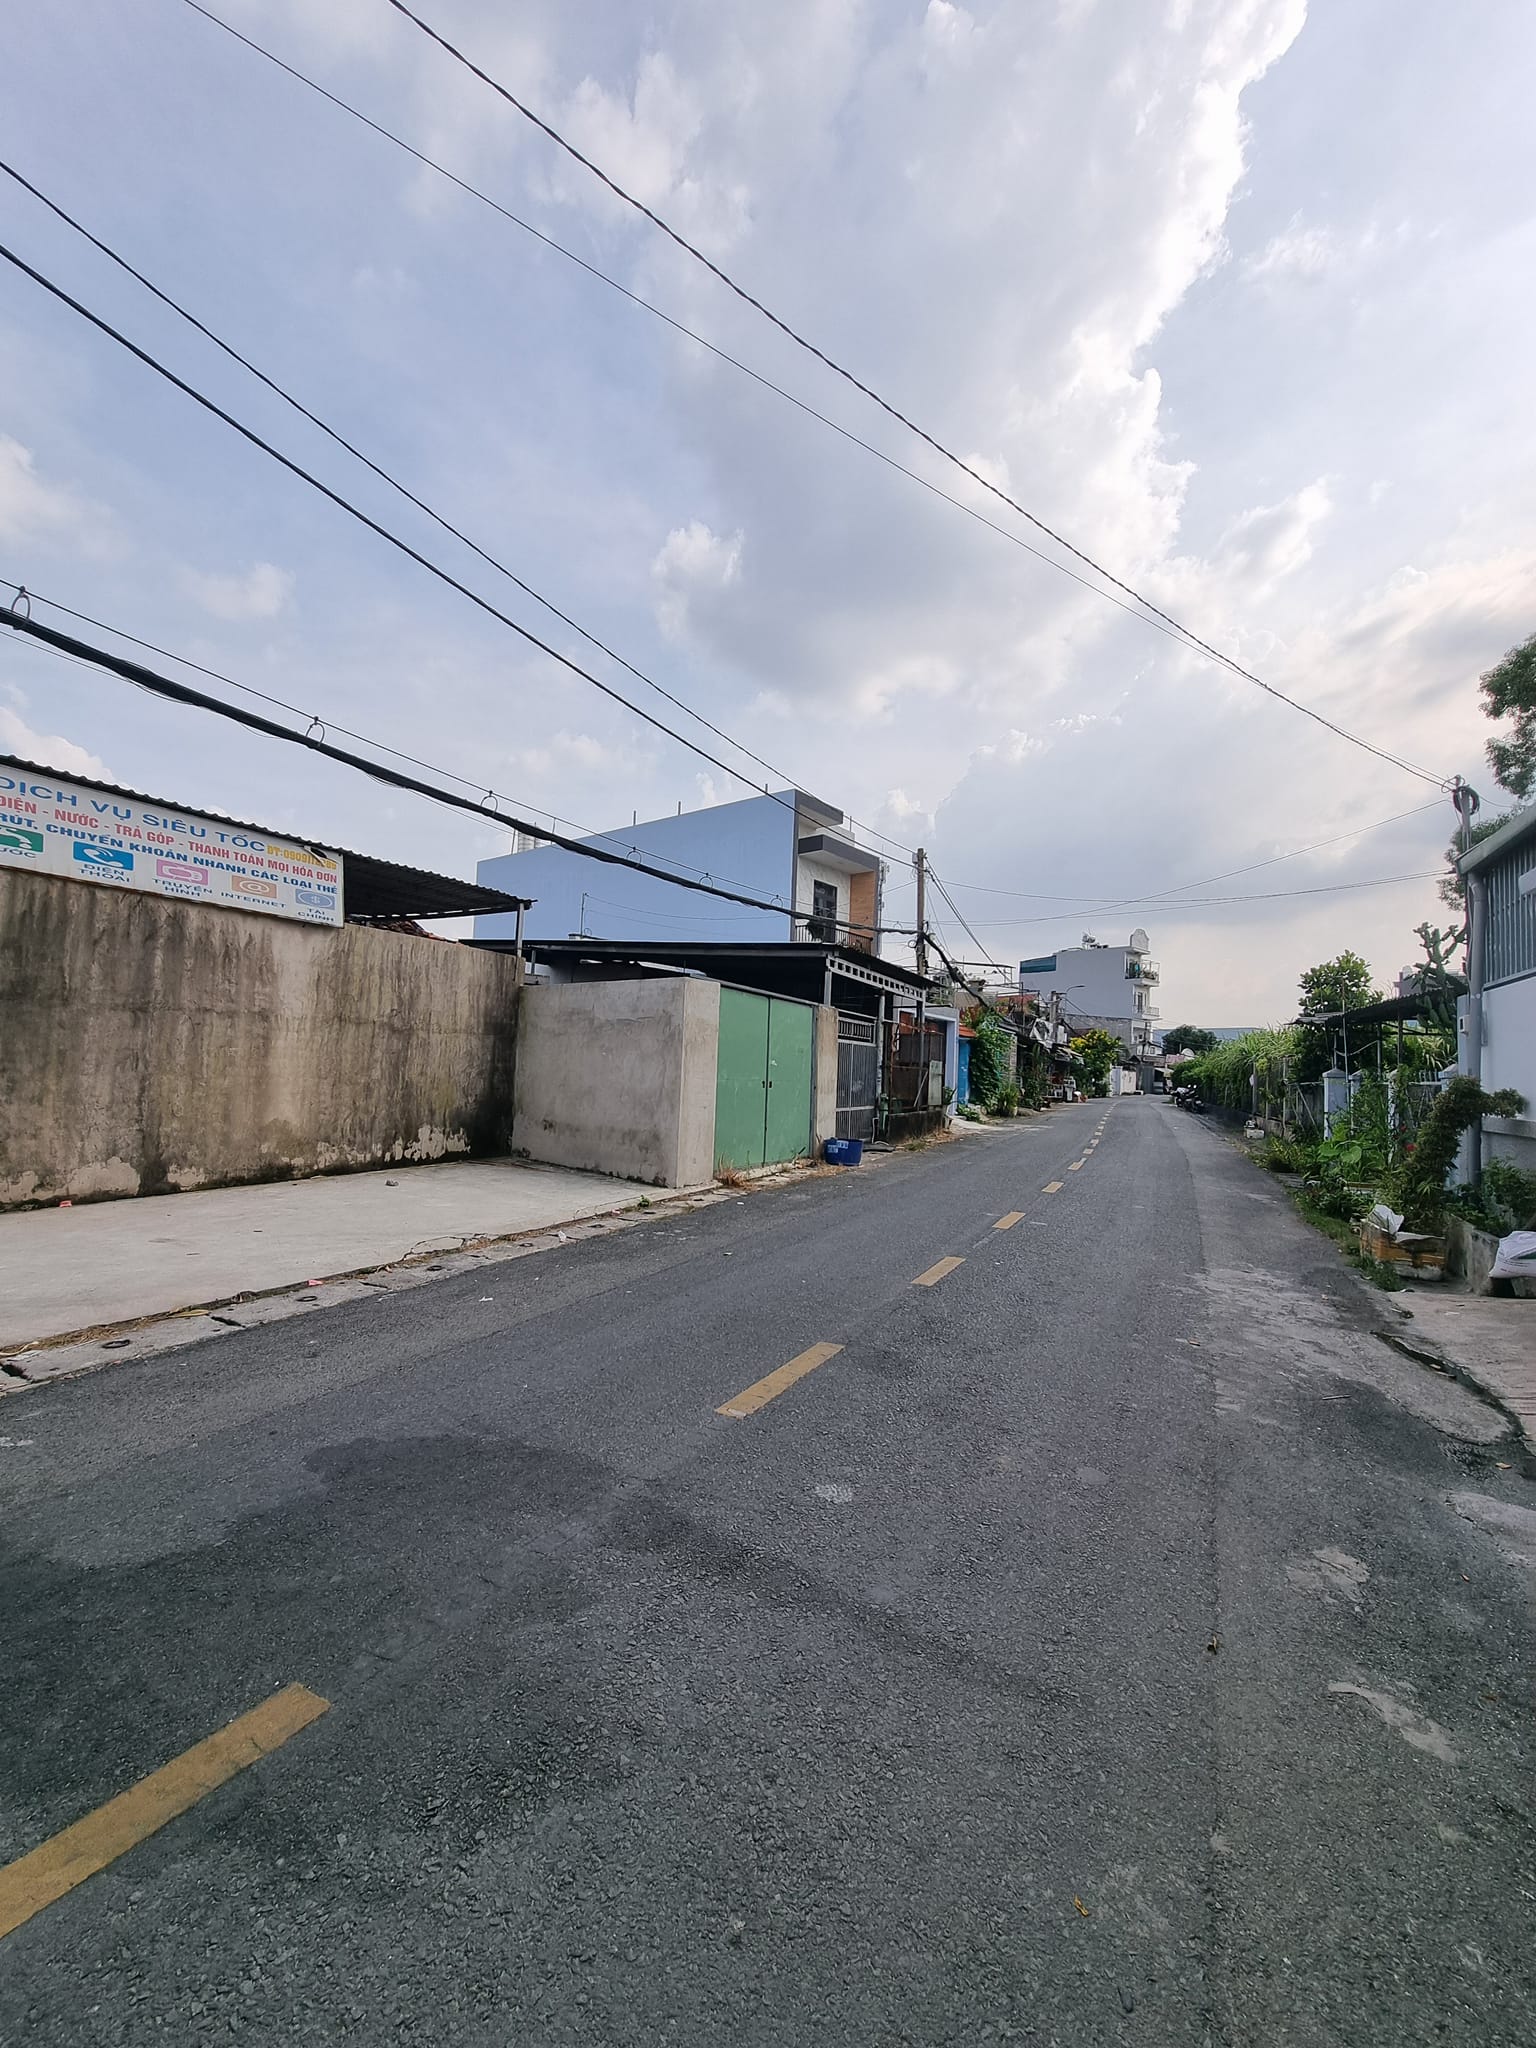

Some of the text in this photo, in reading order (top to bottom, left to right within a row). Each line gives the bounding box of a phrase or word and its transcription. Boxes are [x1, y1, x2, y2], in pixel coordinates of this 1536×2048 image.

[54, 809, 99, 829] NƯỚC
[114, 823, 142, 839] TRẢ
[146, 831, 175, 845] GÓP
[188, 841, 230, 859] THANH
[234, 852, 264, 867] TOÁN
[267, 860, 289, 873] MỌI
[316, 871, 337, 884] ĐƠN
[91, 800, 132, 820] VỤ
[142, 814, 206, 837] SIÊU
[215, 831, 265, 852] TỐC
[193, 856, 246, 875] NHANH
[251, 869, 279, 882] CÁC
[283, 876, 312, 890] LOẠI
[220, 892, 287, 908] INTERNET
